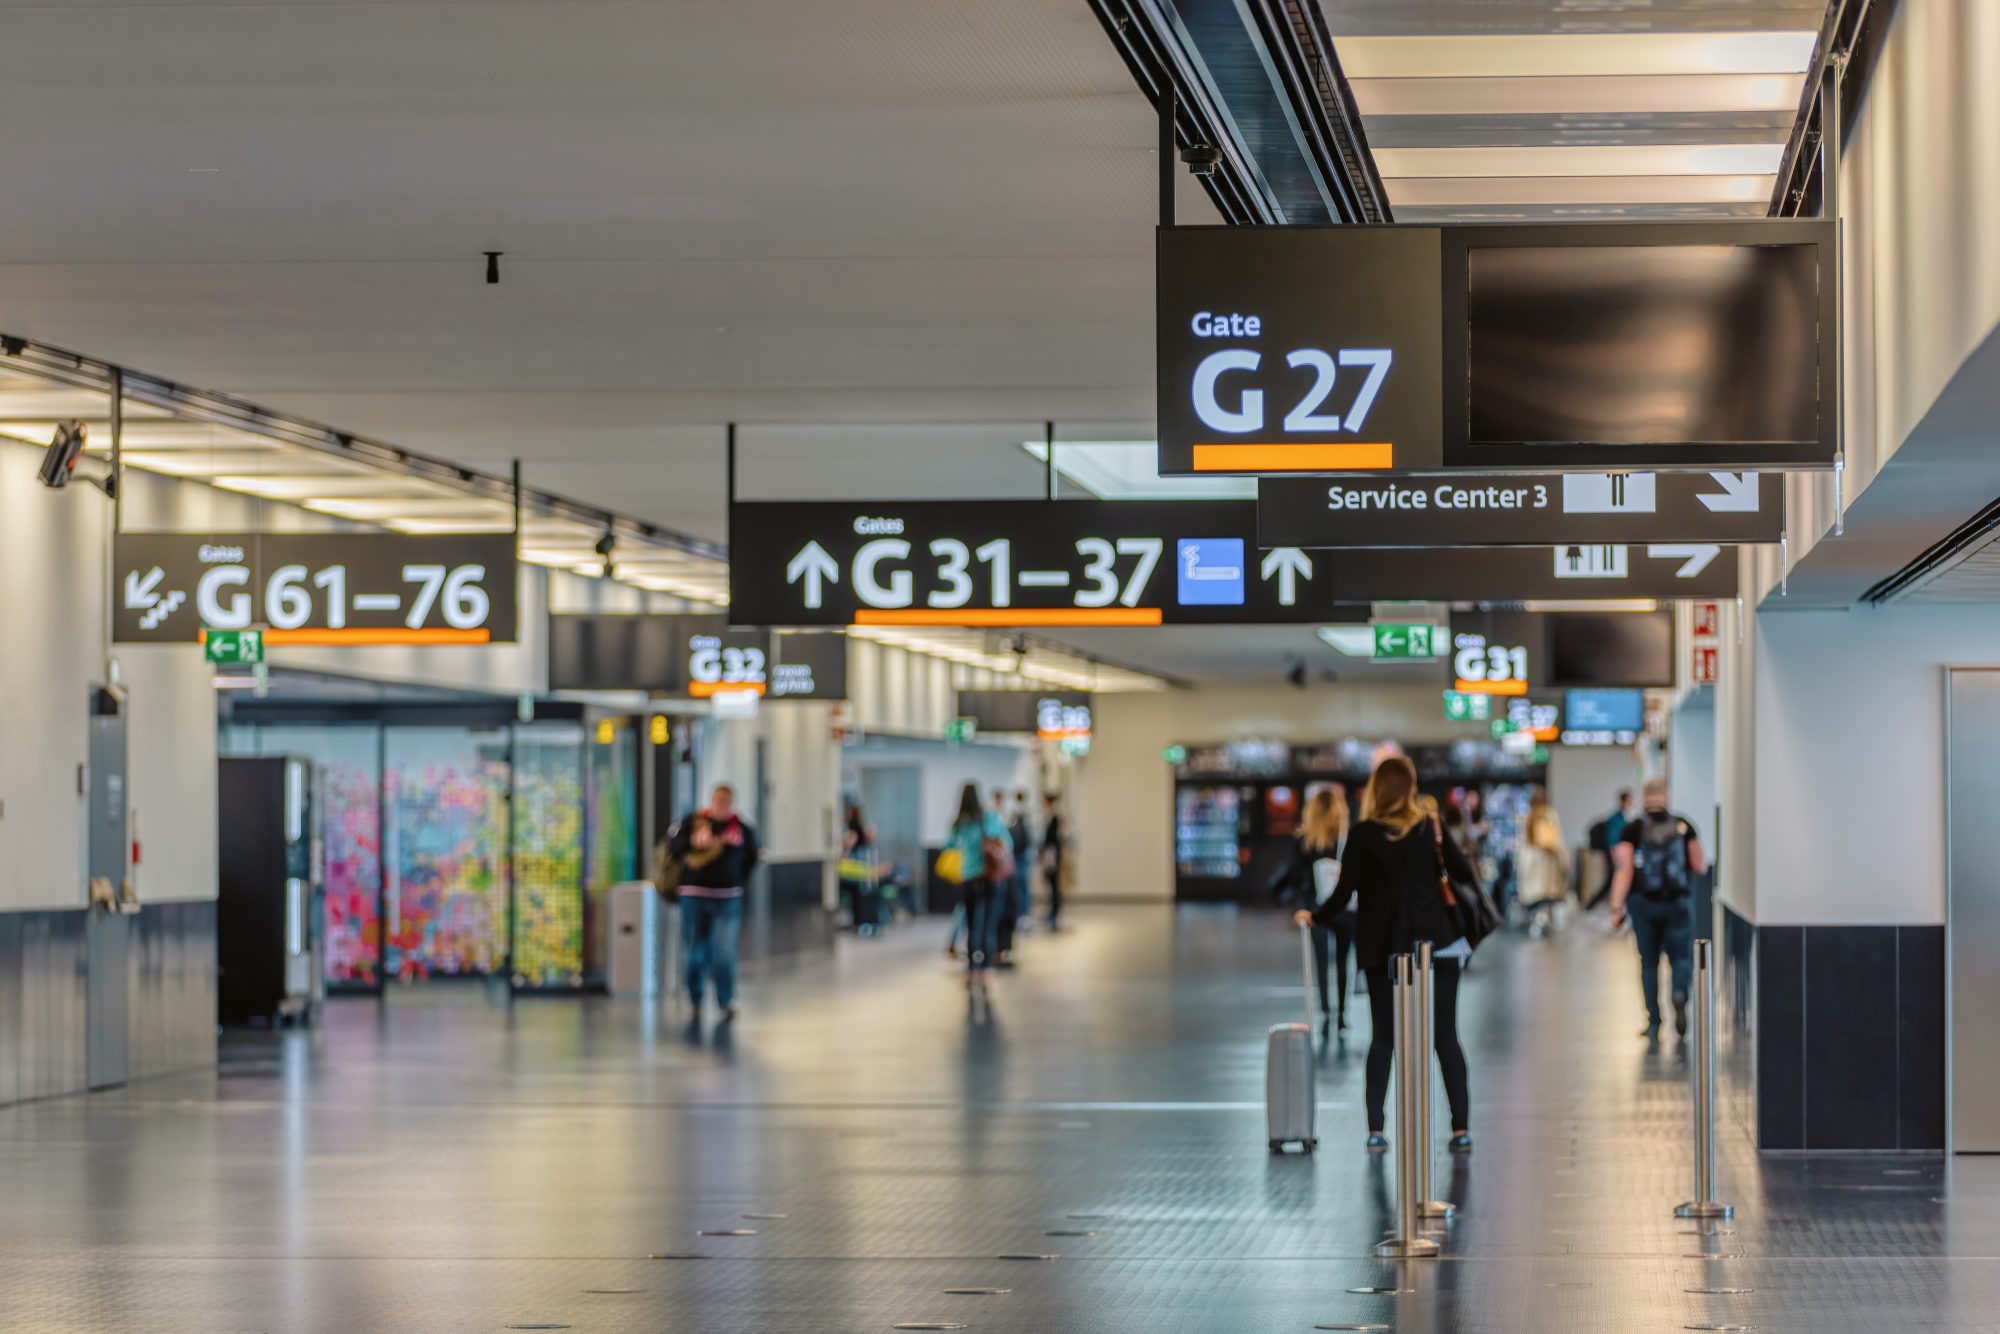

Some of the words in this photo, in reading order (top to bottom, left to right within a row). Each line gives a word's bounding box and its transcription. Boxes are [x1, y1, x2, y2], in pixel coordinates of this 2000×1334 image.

[1192, 312, 1261, 338] Gate
[1191, 348, 1264, 434] G
[1283, 348, 1393, 434] 27
[1328, 485, 1428, 511] Service
[1433, 484, 1528, 510] Center
[1533, 484, 1548, 508] 3
[854, 516, 905, 536] Gates
[198, 544, 244, 565] Gates
[852, 538, 914, 610] G
[197, 564, 252, 630] G
